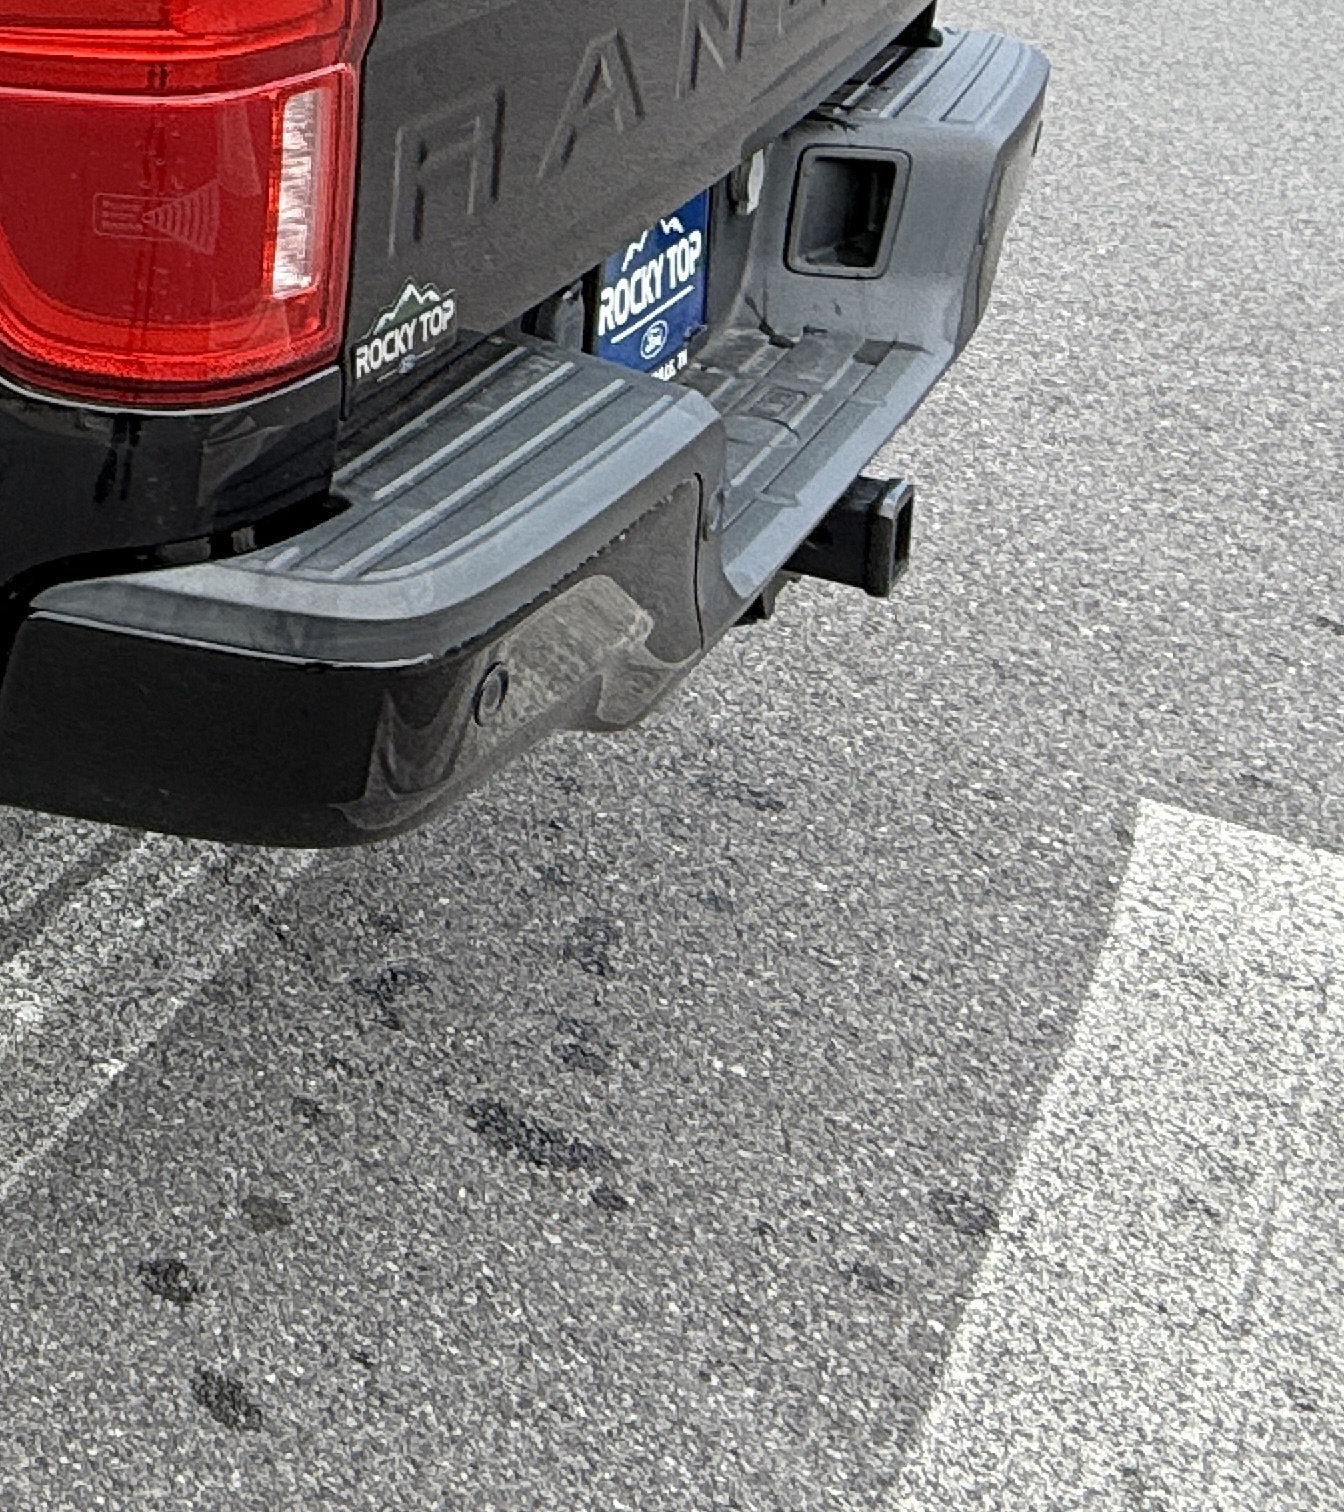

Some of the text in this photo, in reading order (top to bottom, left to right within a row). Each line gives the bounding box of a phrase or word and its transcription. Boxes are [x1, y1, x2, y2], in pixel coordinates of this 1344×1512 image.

[598, 230, 702, 336] ROCKY TOP
[355, 298, 454, 380] ROCKY TOP
